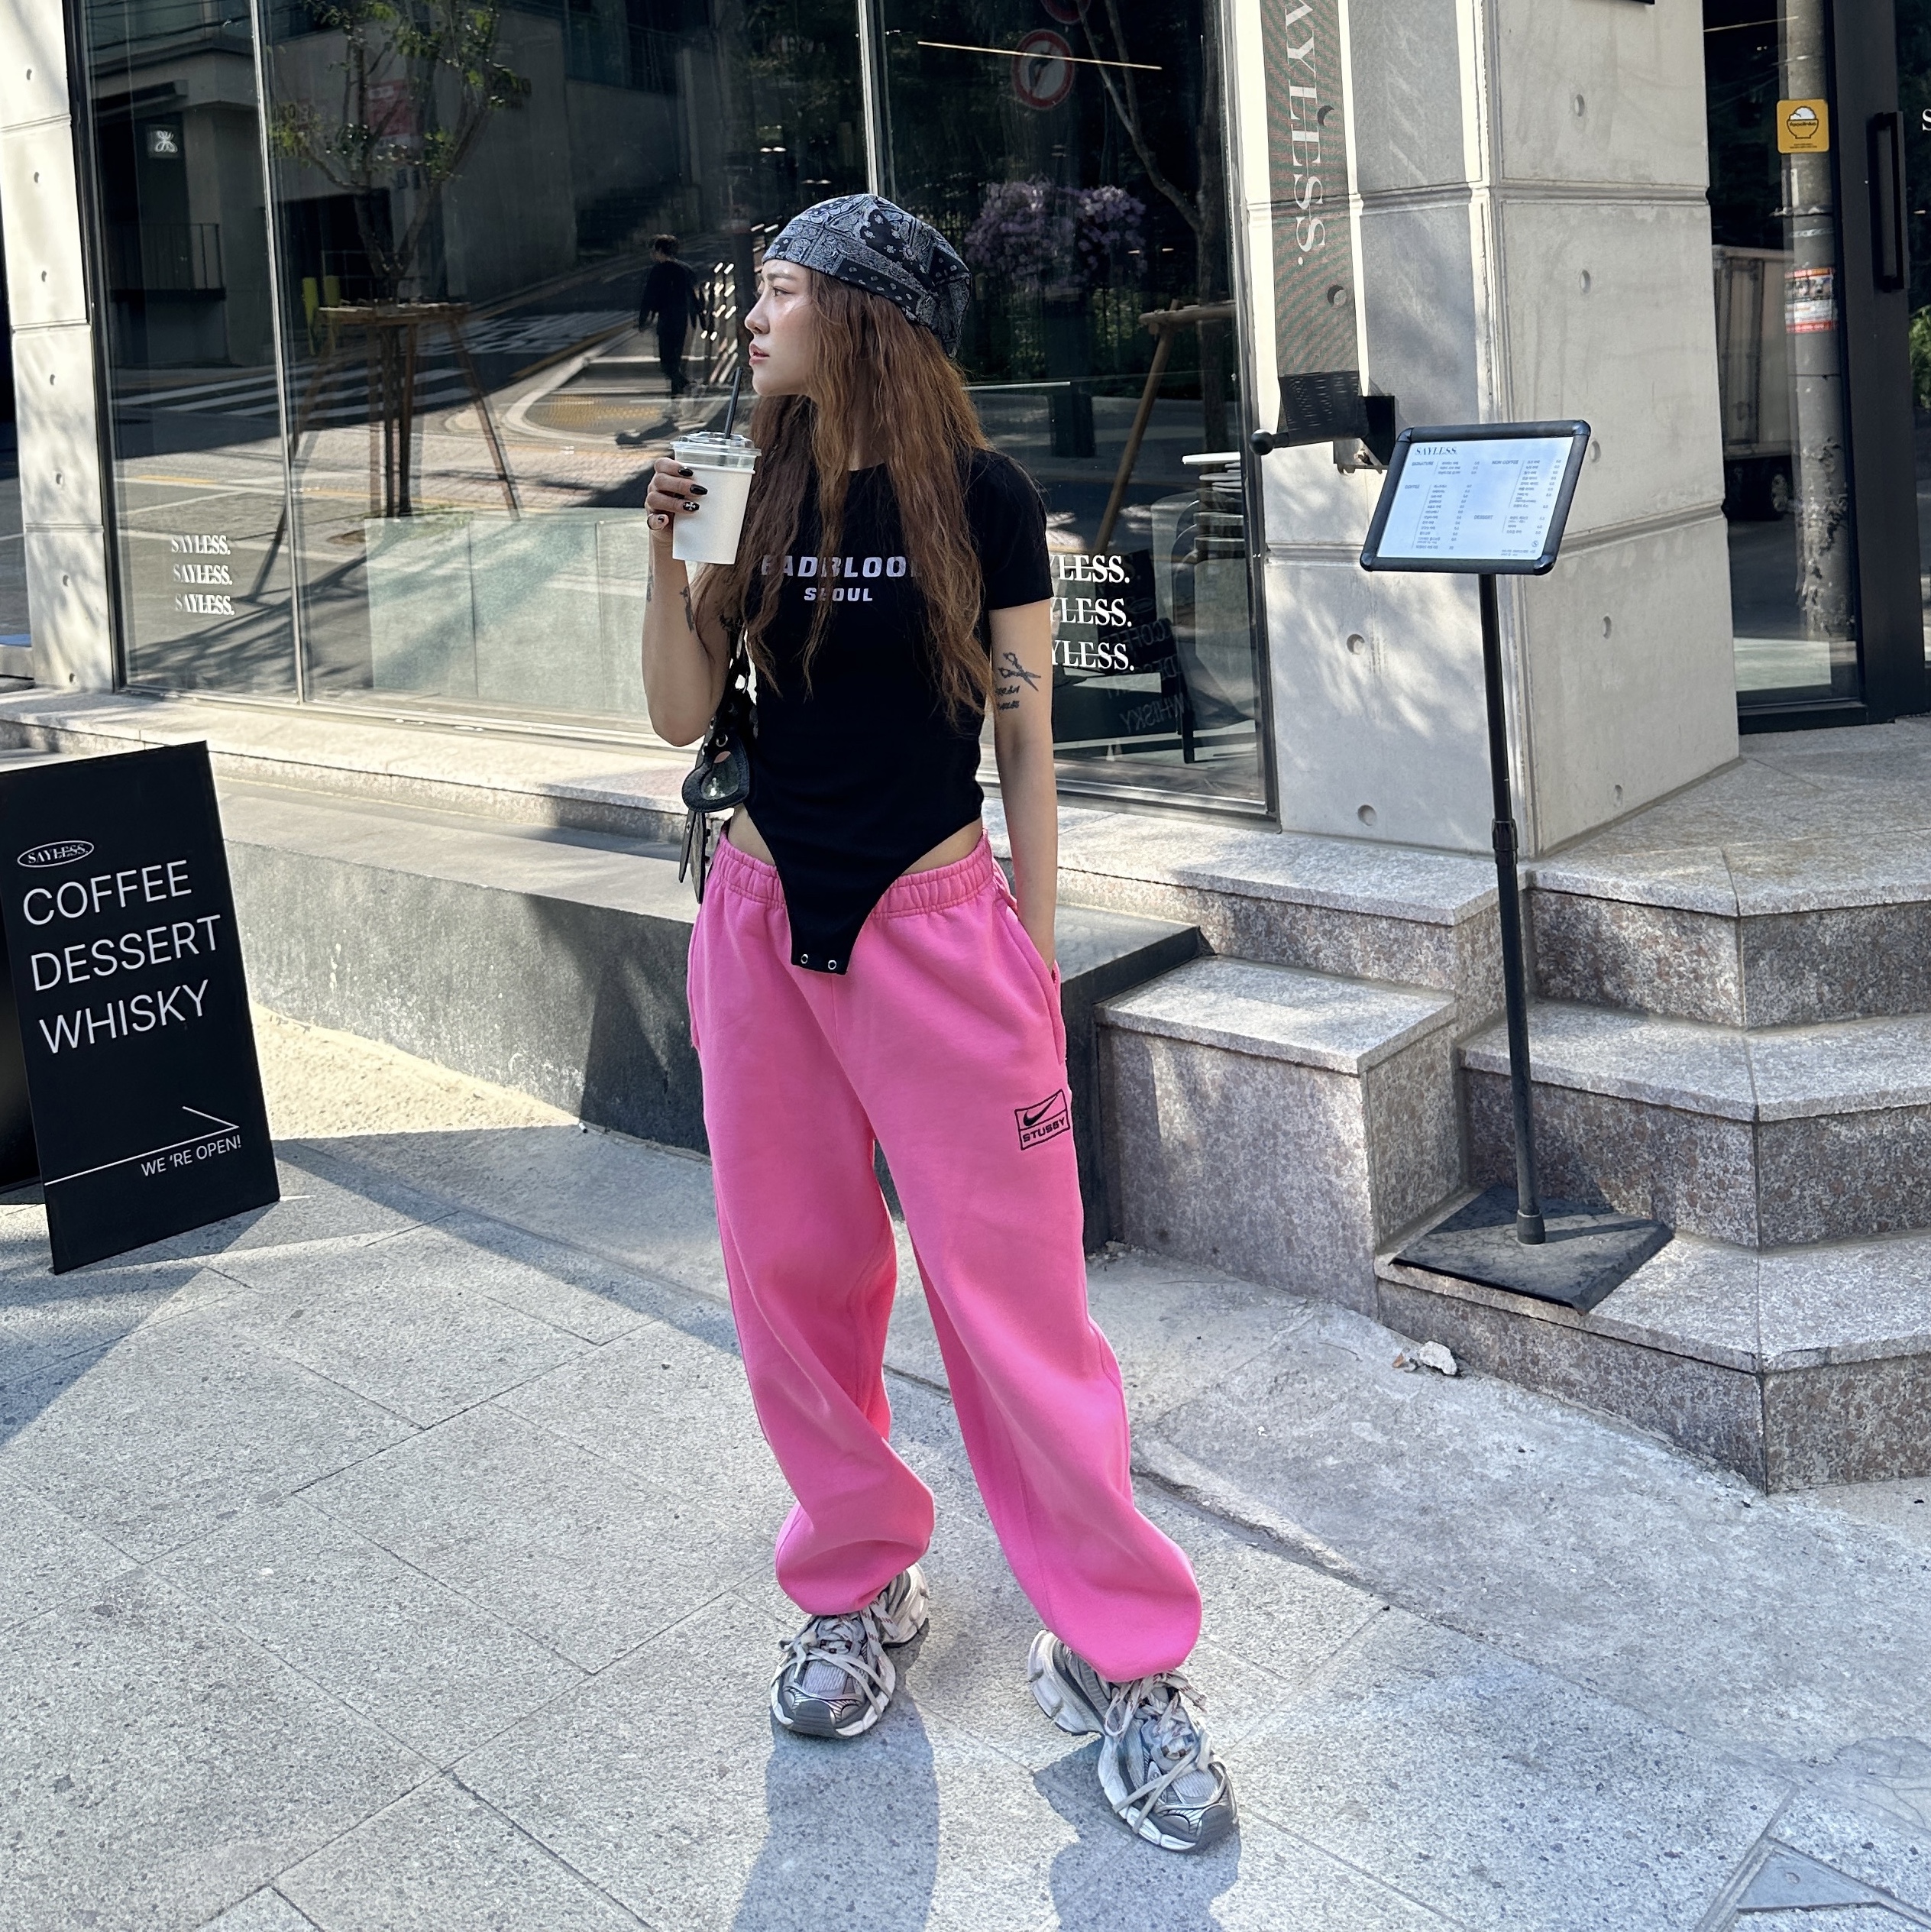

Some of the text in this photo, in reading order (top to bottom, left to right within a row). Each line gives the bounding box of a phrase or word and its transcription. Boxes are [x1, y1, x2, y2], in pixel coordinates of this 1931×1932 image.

[1285, 0, 1326, 266] AYLESS.
[171, 535, 231, 555] SAYLESS.
[173, 564, 233, 585] SAYLESS.
[175, 594, 235, 616] SAYLESS.
[1051, 640, 1135, 672] YLESS.
[27, 843, 89, 864] SAYLESS.
[23, 859, 192, 925] COFFEE
[31, 914, 221, 991] DESSERT
[39, 979, 209, 1053] WHISKY
[1022, 1117, 1065, 1143] STUSSY
[141, 1157, 167, 1176] WE
[196, 1134, 242, 1160] OPEN!
